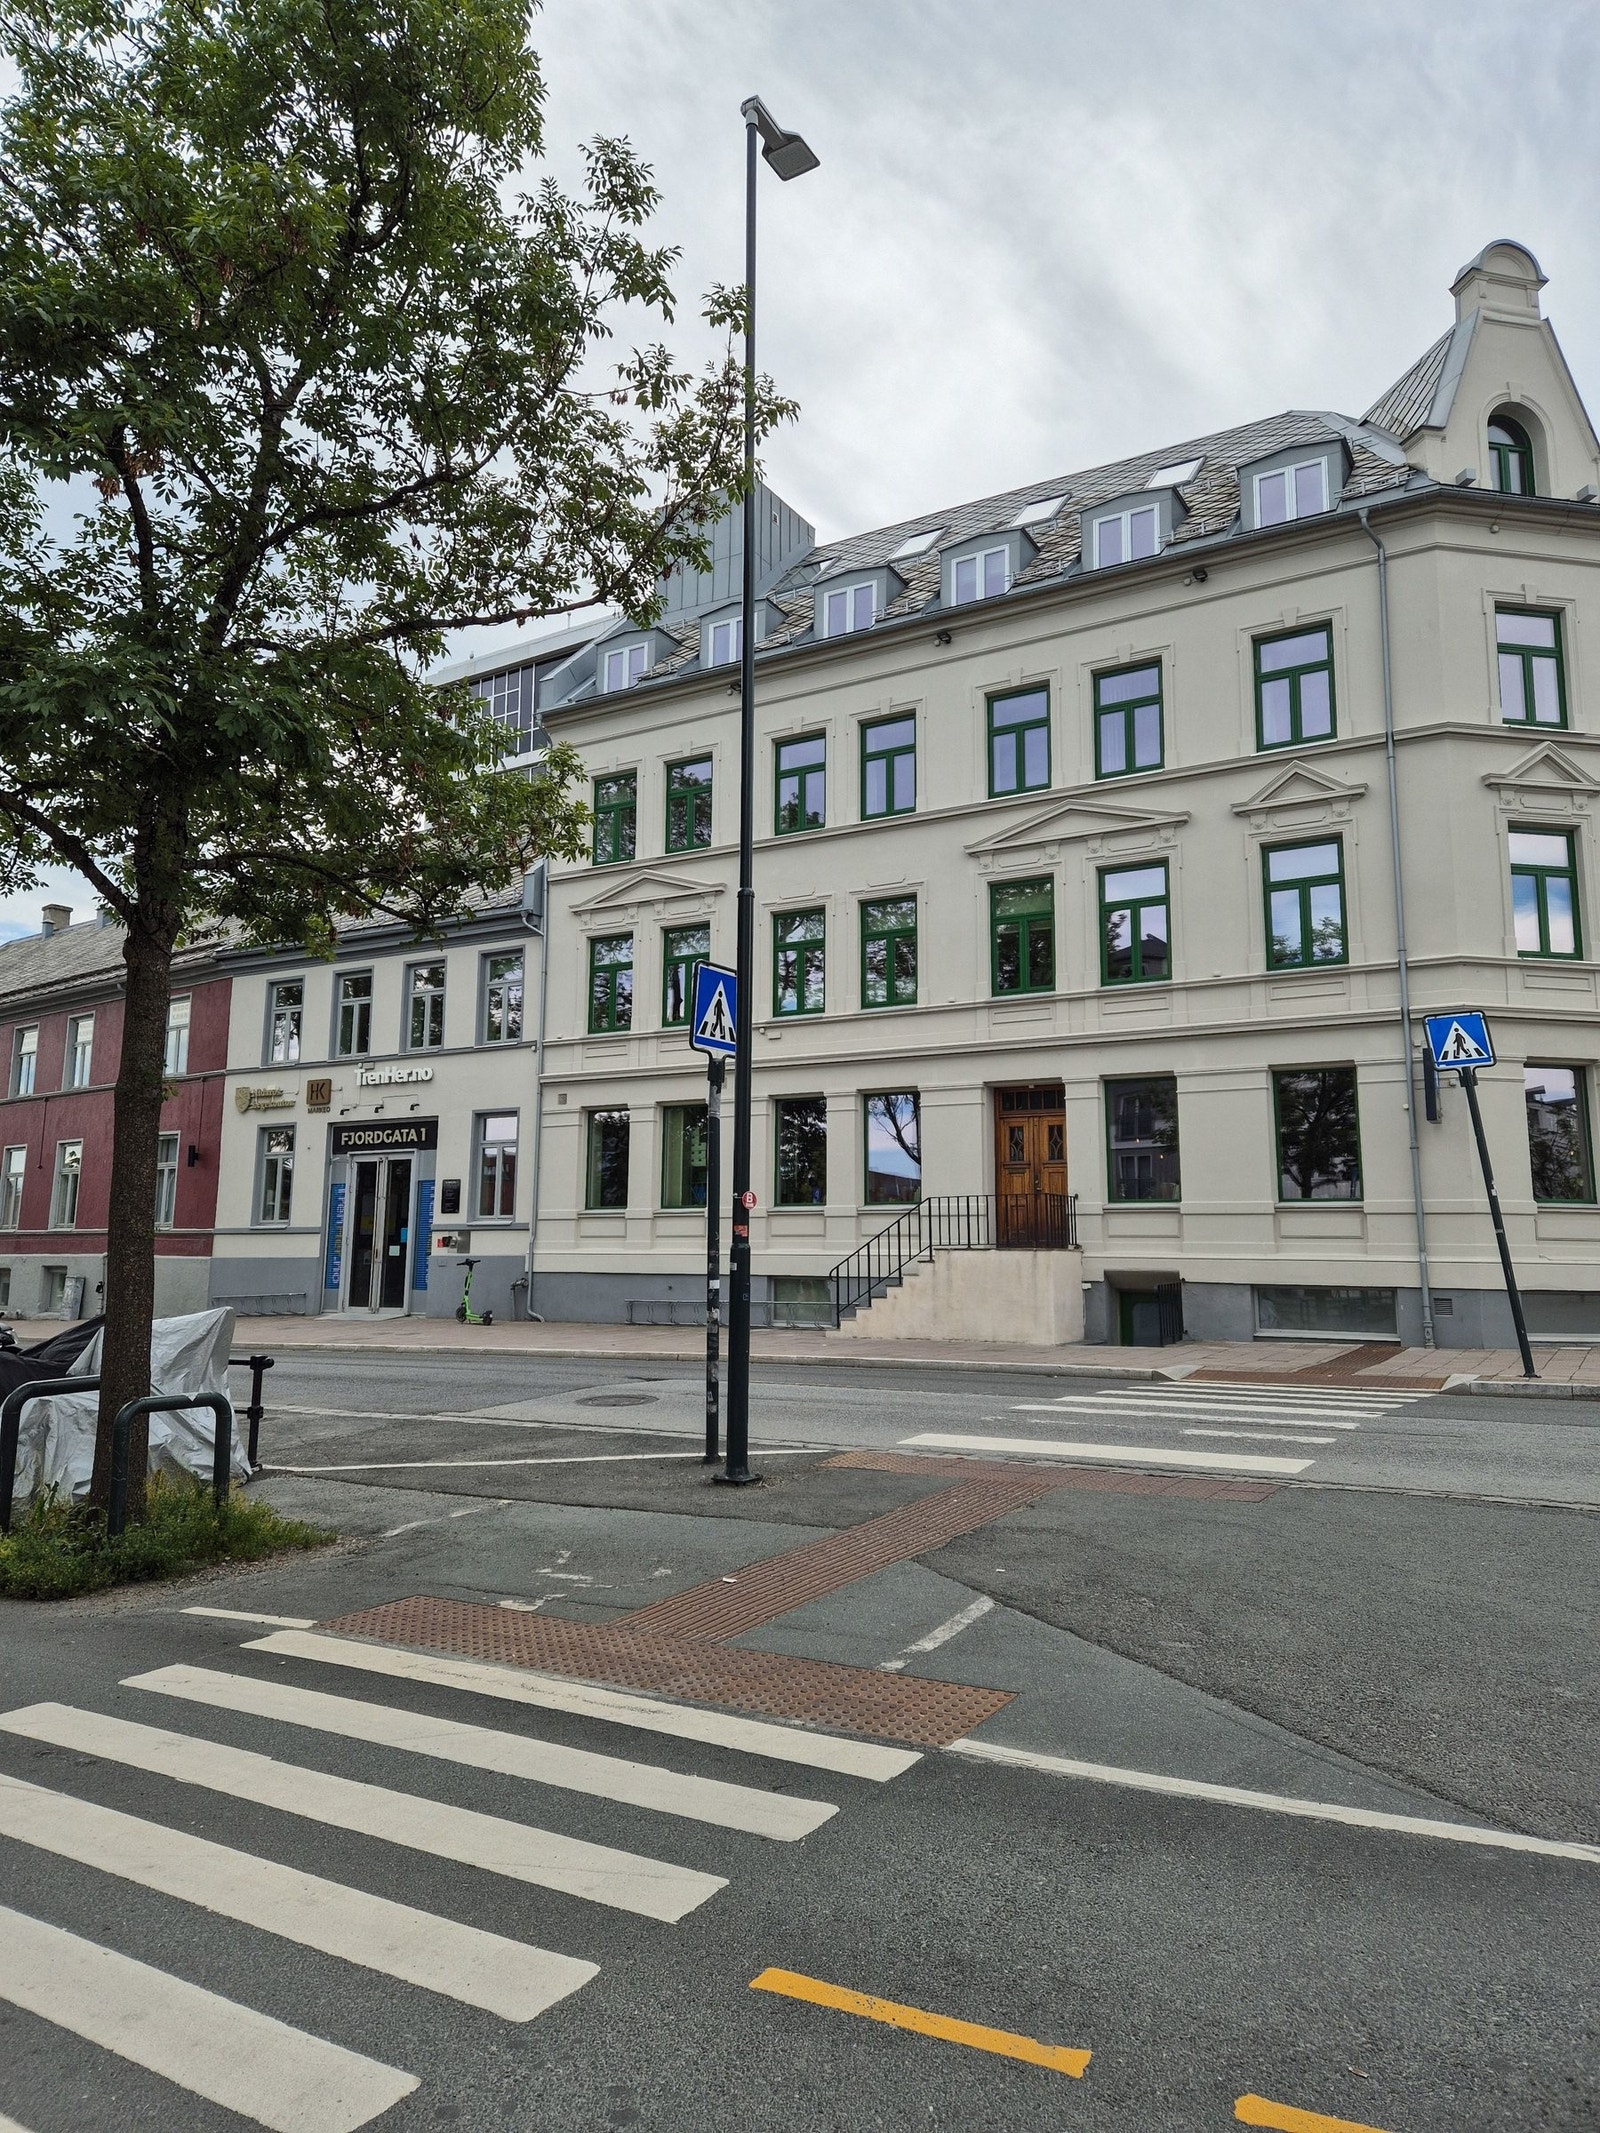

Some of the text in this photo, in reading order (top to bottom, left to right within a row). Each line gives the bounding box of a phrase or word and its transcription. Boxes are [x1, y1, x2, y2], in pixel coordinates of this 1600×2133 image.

[354, 1065, 433, 1086] TrenHer.no
[310, 1082, 326, 1101] HK
[341, 1127, 426, 1146] FJORDGATA 1
[746, 1193, 753, 1203] B
